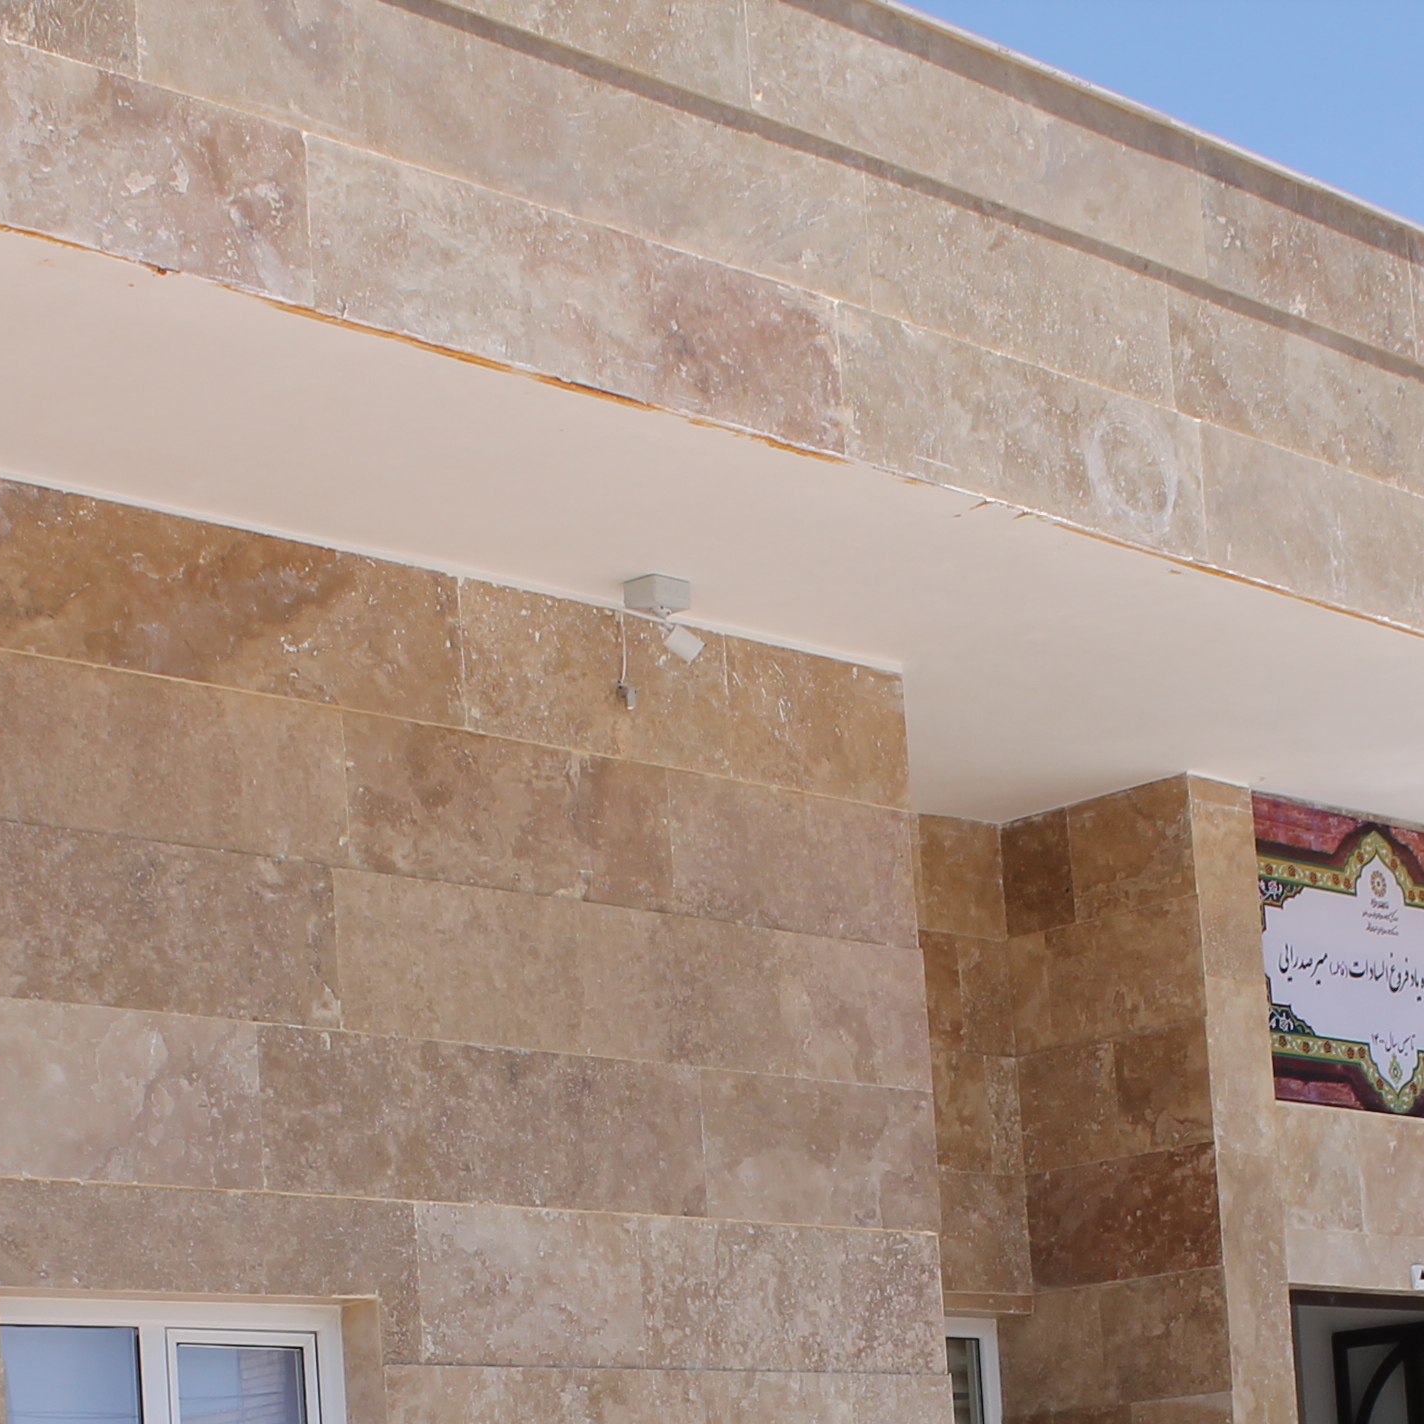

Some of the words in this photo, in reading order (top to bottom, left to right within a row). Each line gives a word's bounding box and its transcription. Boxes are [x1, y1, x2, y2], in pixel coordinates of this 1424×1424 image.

[1349, 959, 1388, 982] السادات
[1389, 952, 1410, 993] فروغ
[1385, 1031, 1398, 1052] سال
